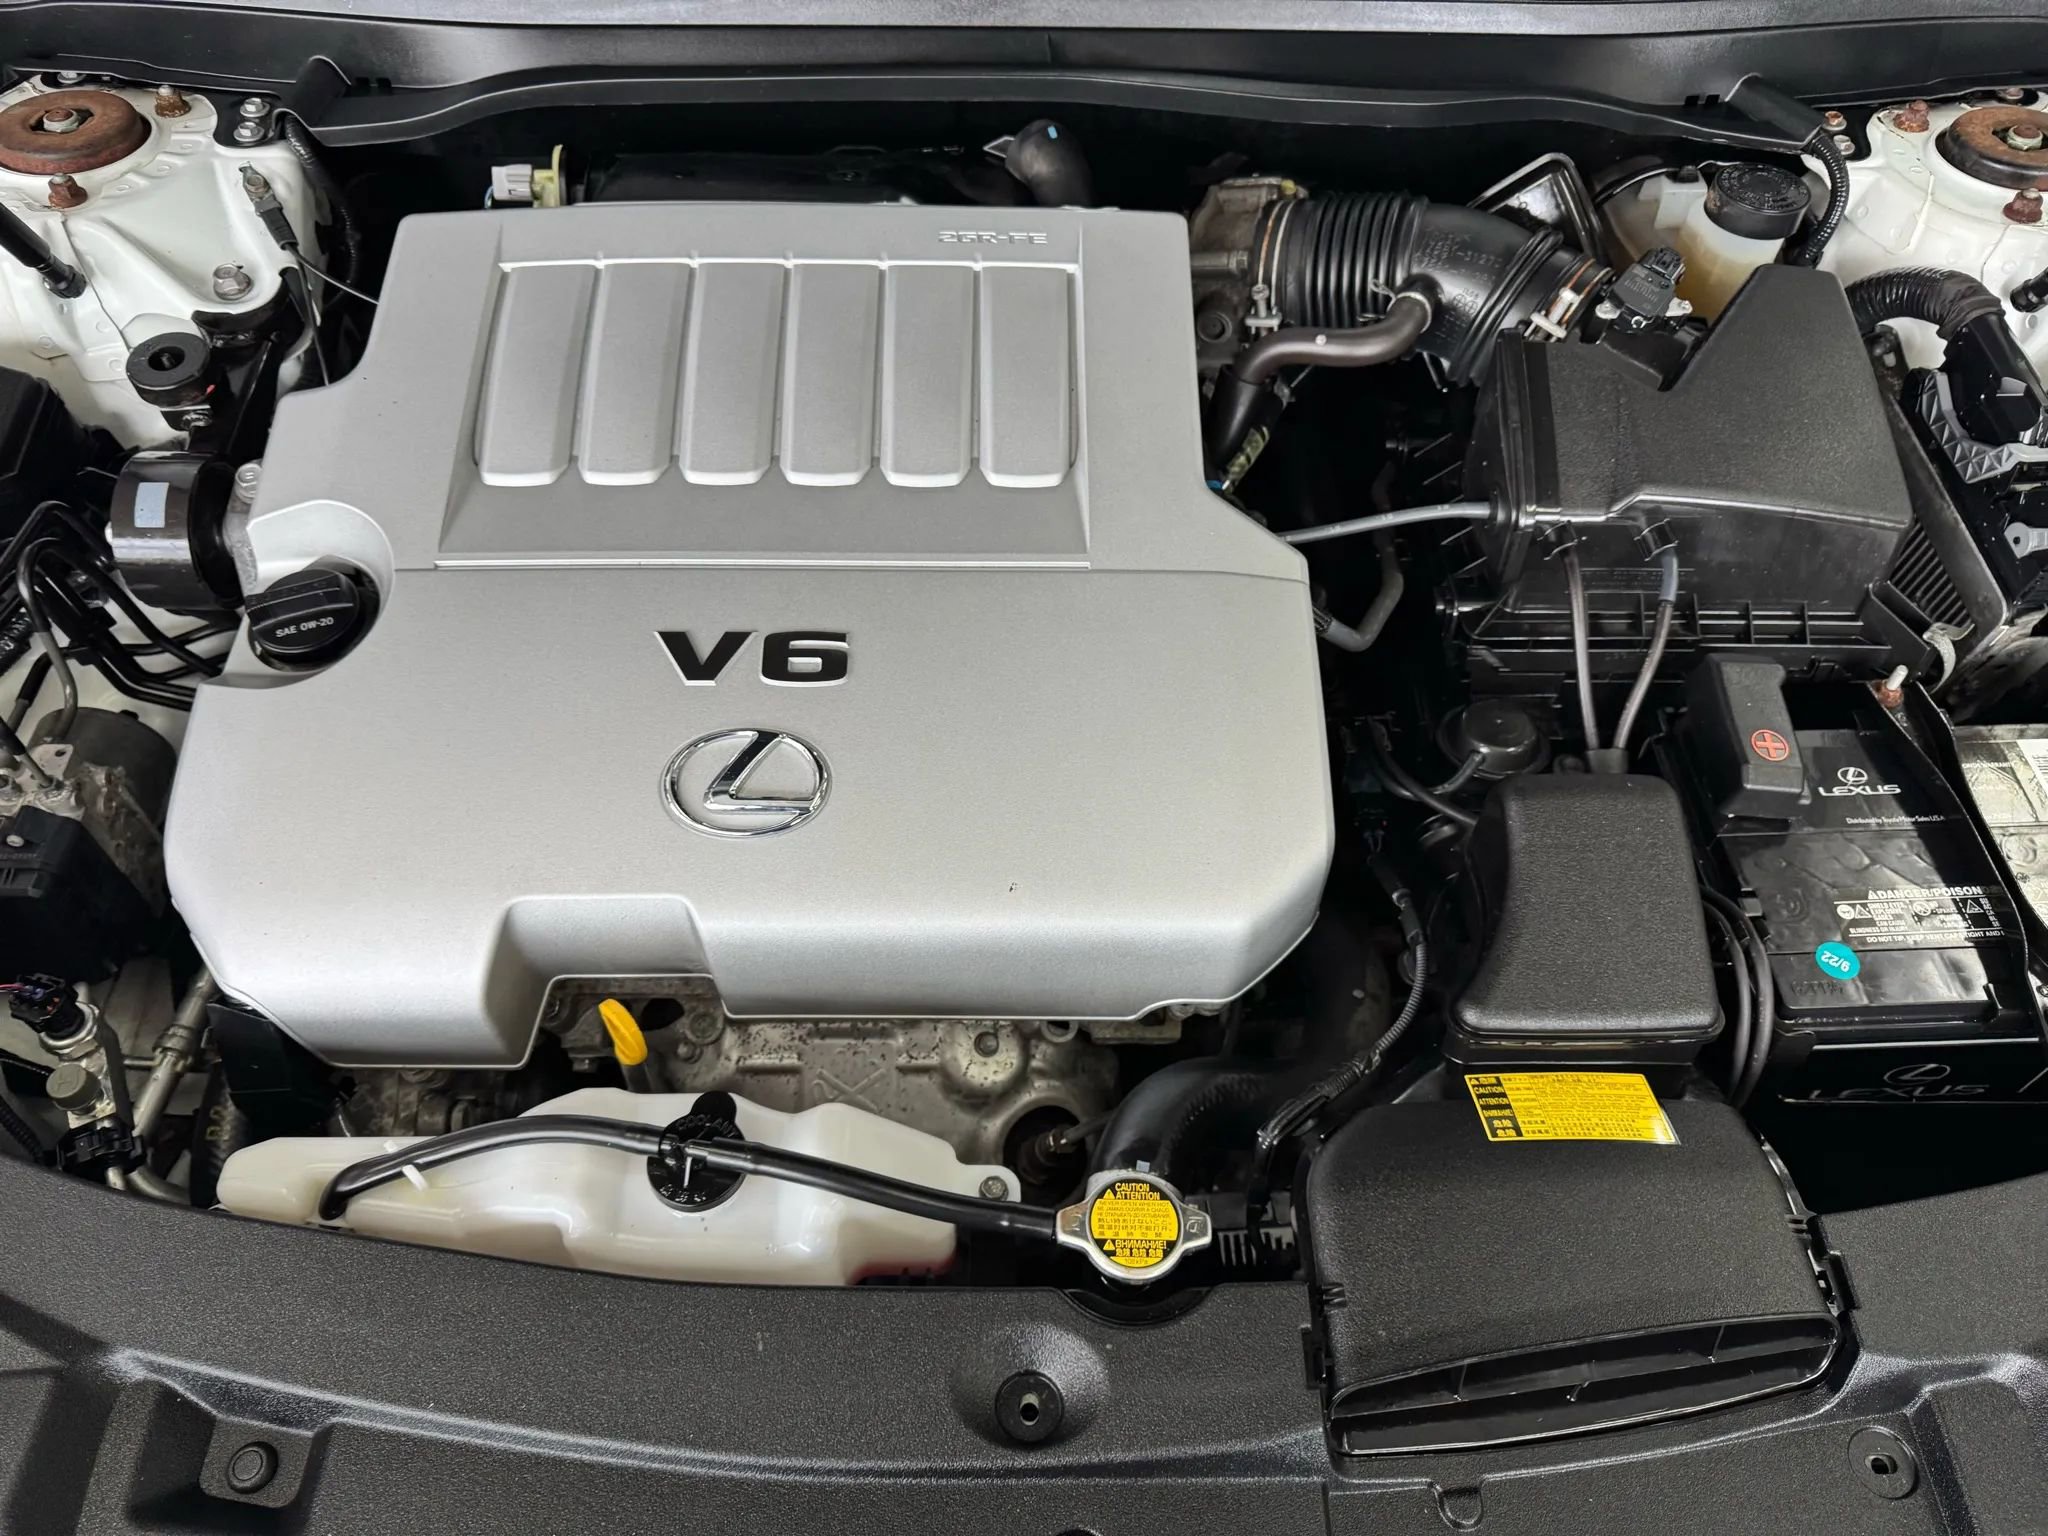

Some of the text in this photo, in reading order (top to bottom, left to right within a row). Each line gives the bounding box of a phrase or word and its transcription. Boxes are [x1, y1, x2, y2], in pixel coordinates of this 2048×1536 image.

[938, 231, 1048, 244] 2GR-FE
[275, 616, 334, 638] SAE 0W-20
[653, 631, 850, 687] V6
[1817, 784, 1902, 797] LEXUS
[1876, 886, 1984, 900] DANGER/POISON
[1821, 950, 1851, 972] 9/22
[1473, 1086, 1505, 1095] CAUTION
[1809, 1084, 1990, 1100] LEXUS
[1478, 1097, 1510, 1105] ATTENTION
[1115, 1182, 1150, 1192] CAUTION
[1115, 1191, 1161, 1200] ATTENTION
[1115, 1239, 1167, 1250] ВНИМАНИЕ!
